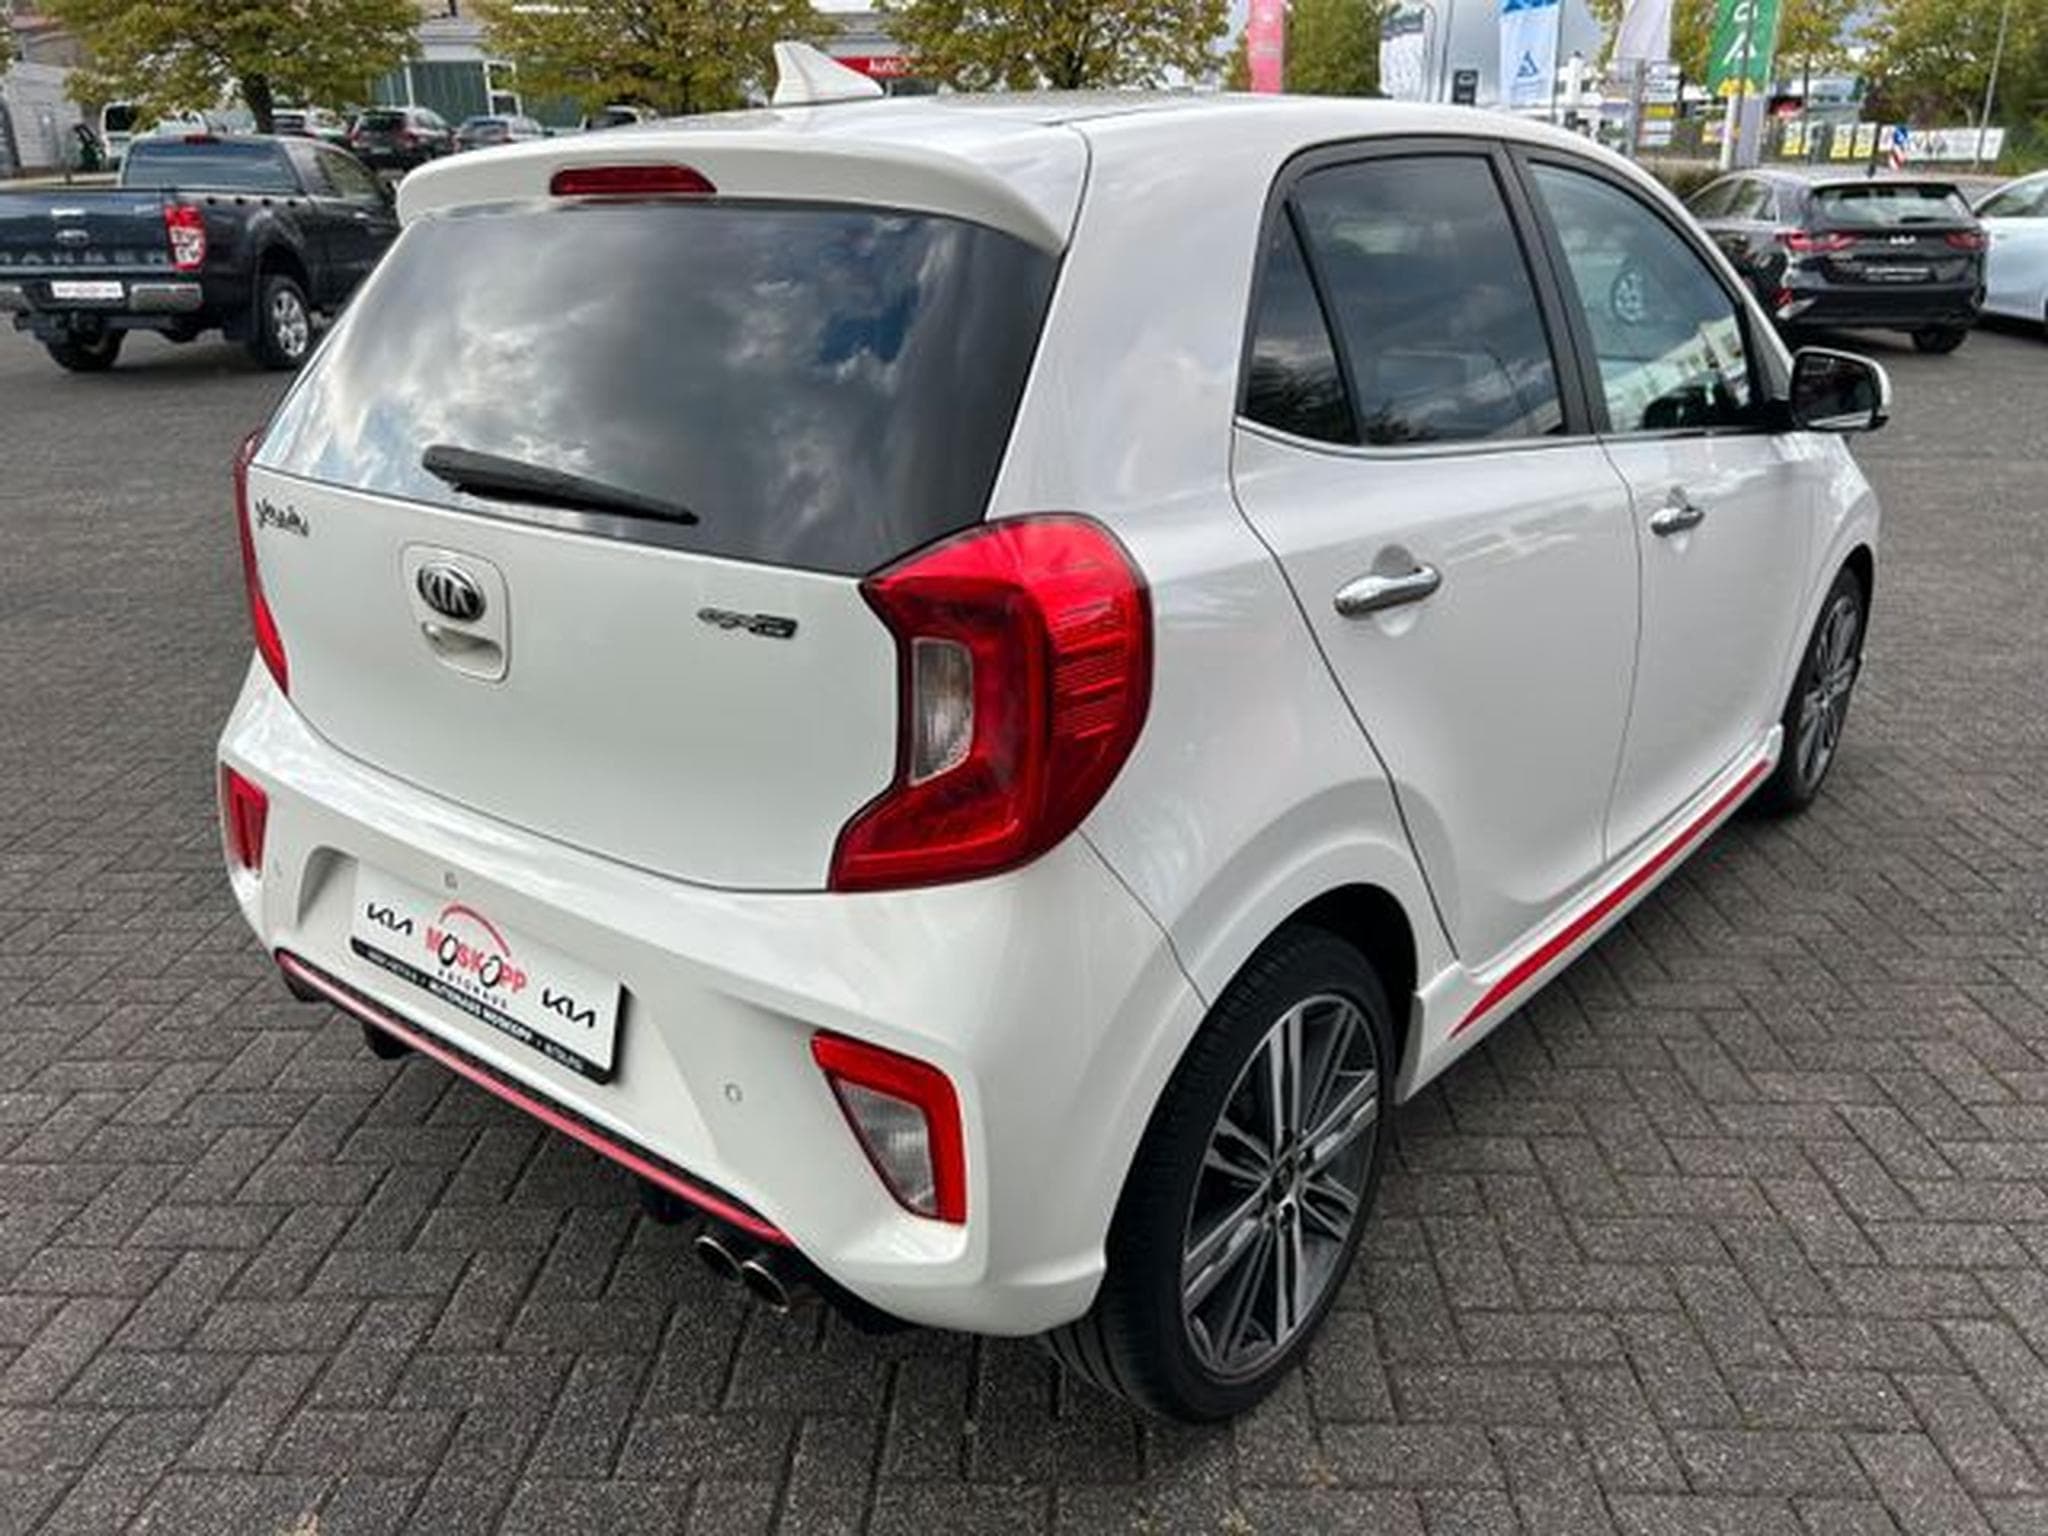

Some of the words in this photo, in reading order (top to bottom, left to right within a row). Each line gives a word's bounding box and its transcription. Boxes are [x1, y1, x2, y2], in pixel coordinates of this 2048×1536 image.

[420, 566, 474, 616] KIA
[366, 902, 414, 937] KIA
[423, 923, 529, 994] MOSKOPP
[541, 987, 597, 1029] KIA
